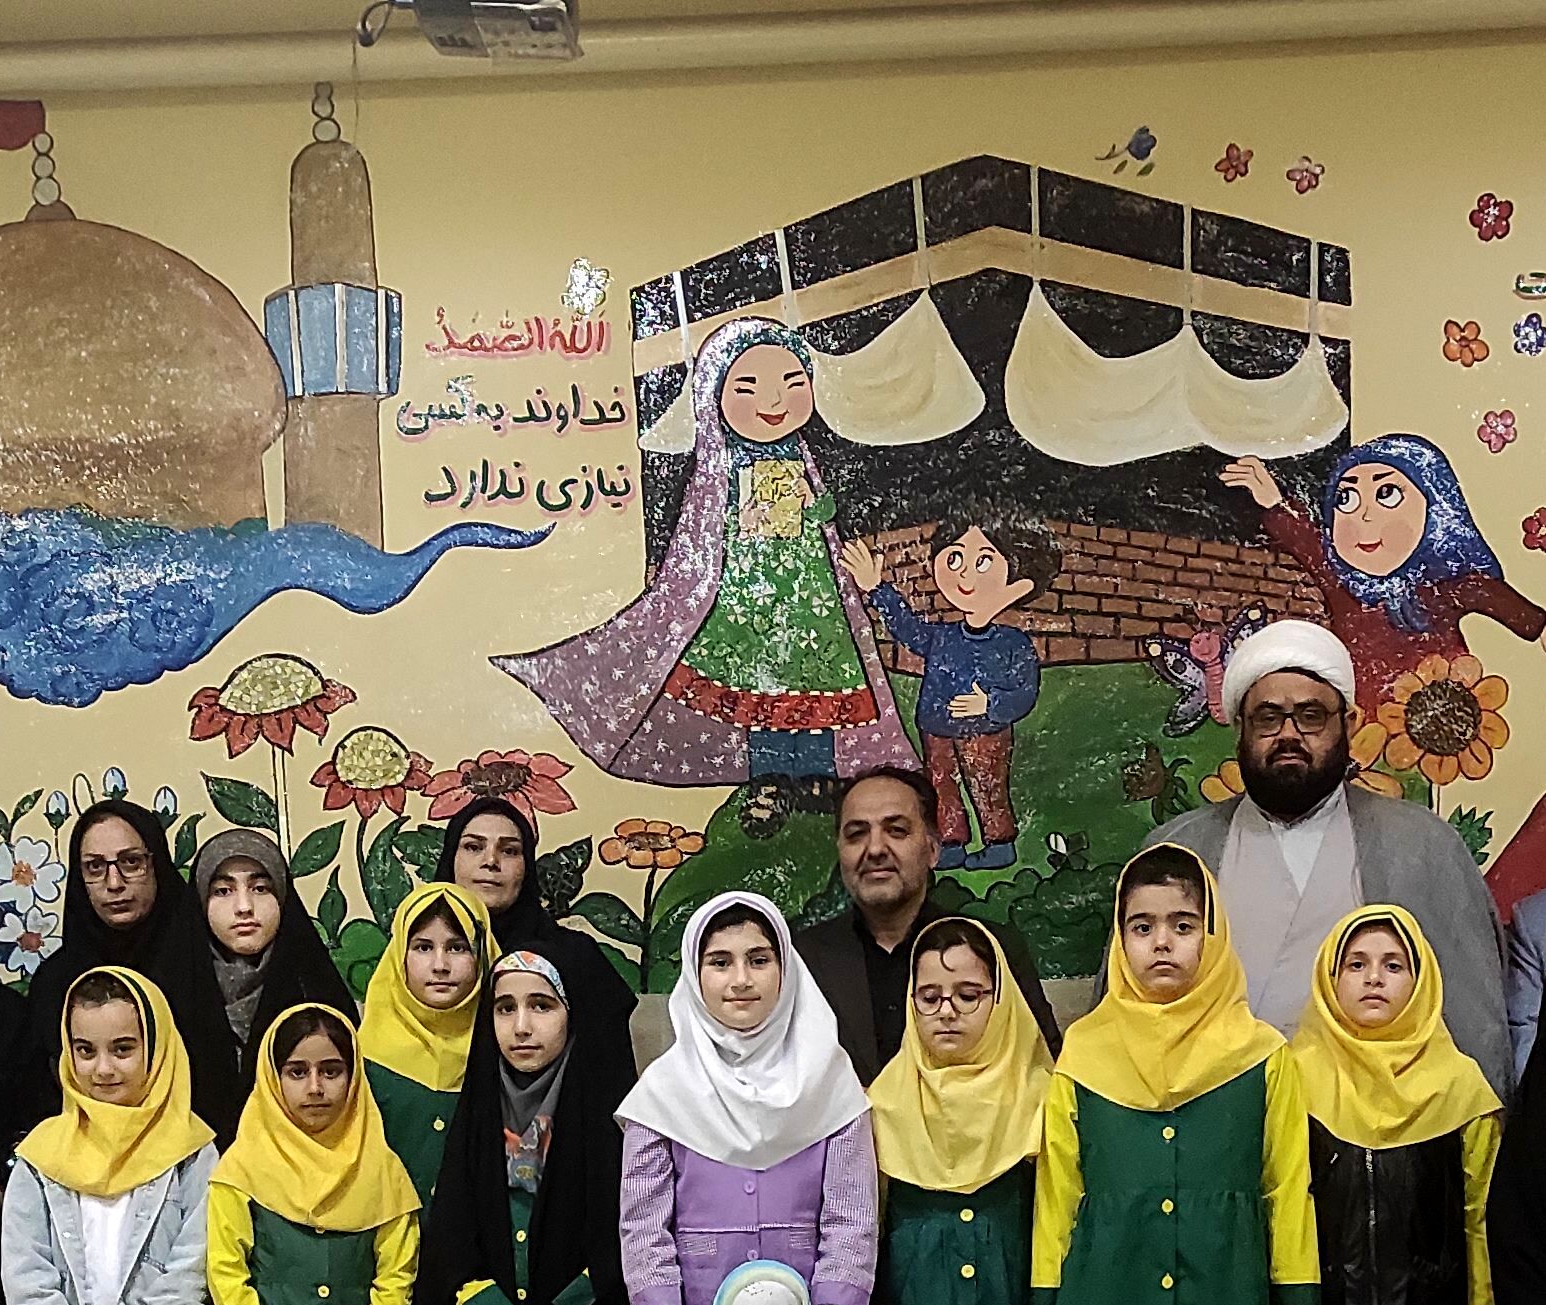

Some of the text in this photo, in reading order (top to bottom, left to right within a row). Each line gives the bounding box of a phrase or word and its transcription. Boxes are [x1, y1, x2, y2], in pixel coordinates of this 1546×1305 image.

[396, 374, 632, 442] خداوند به کسی
[422, 457, 638, 518] نیازی ندارد
